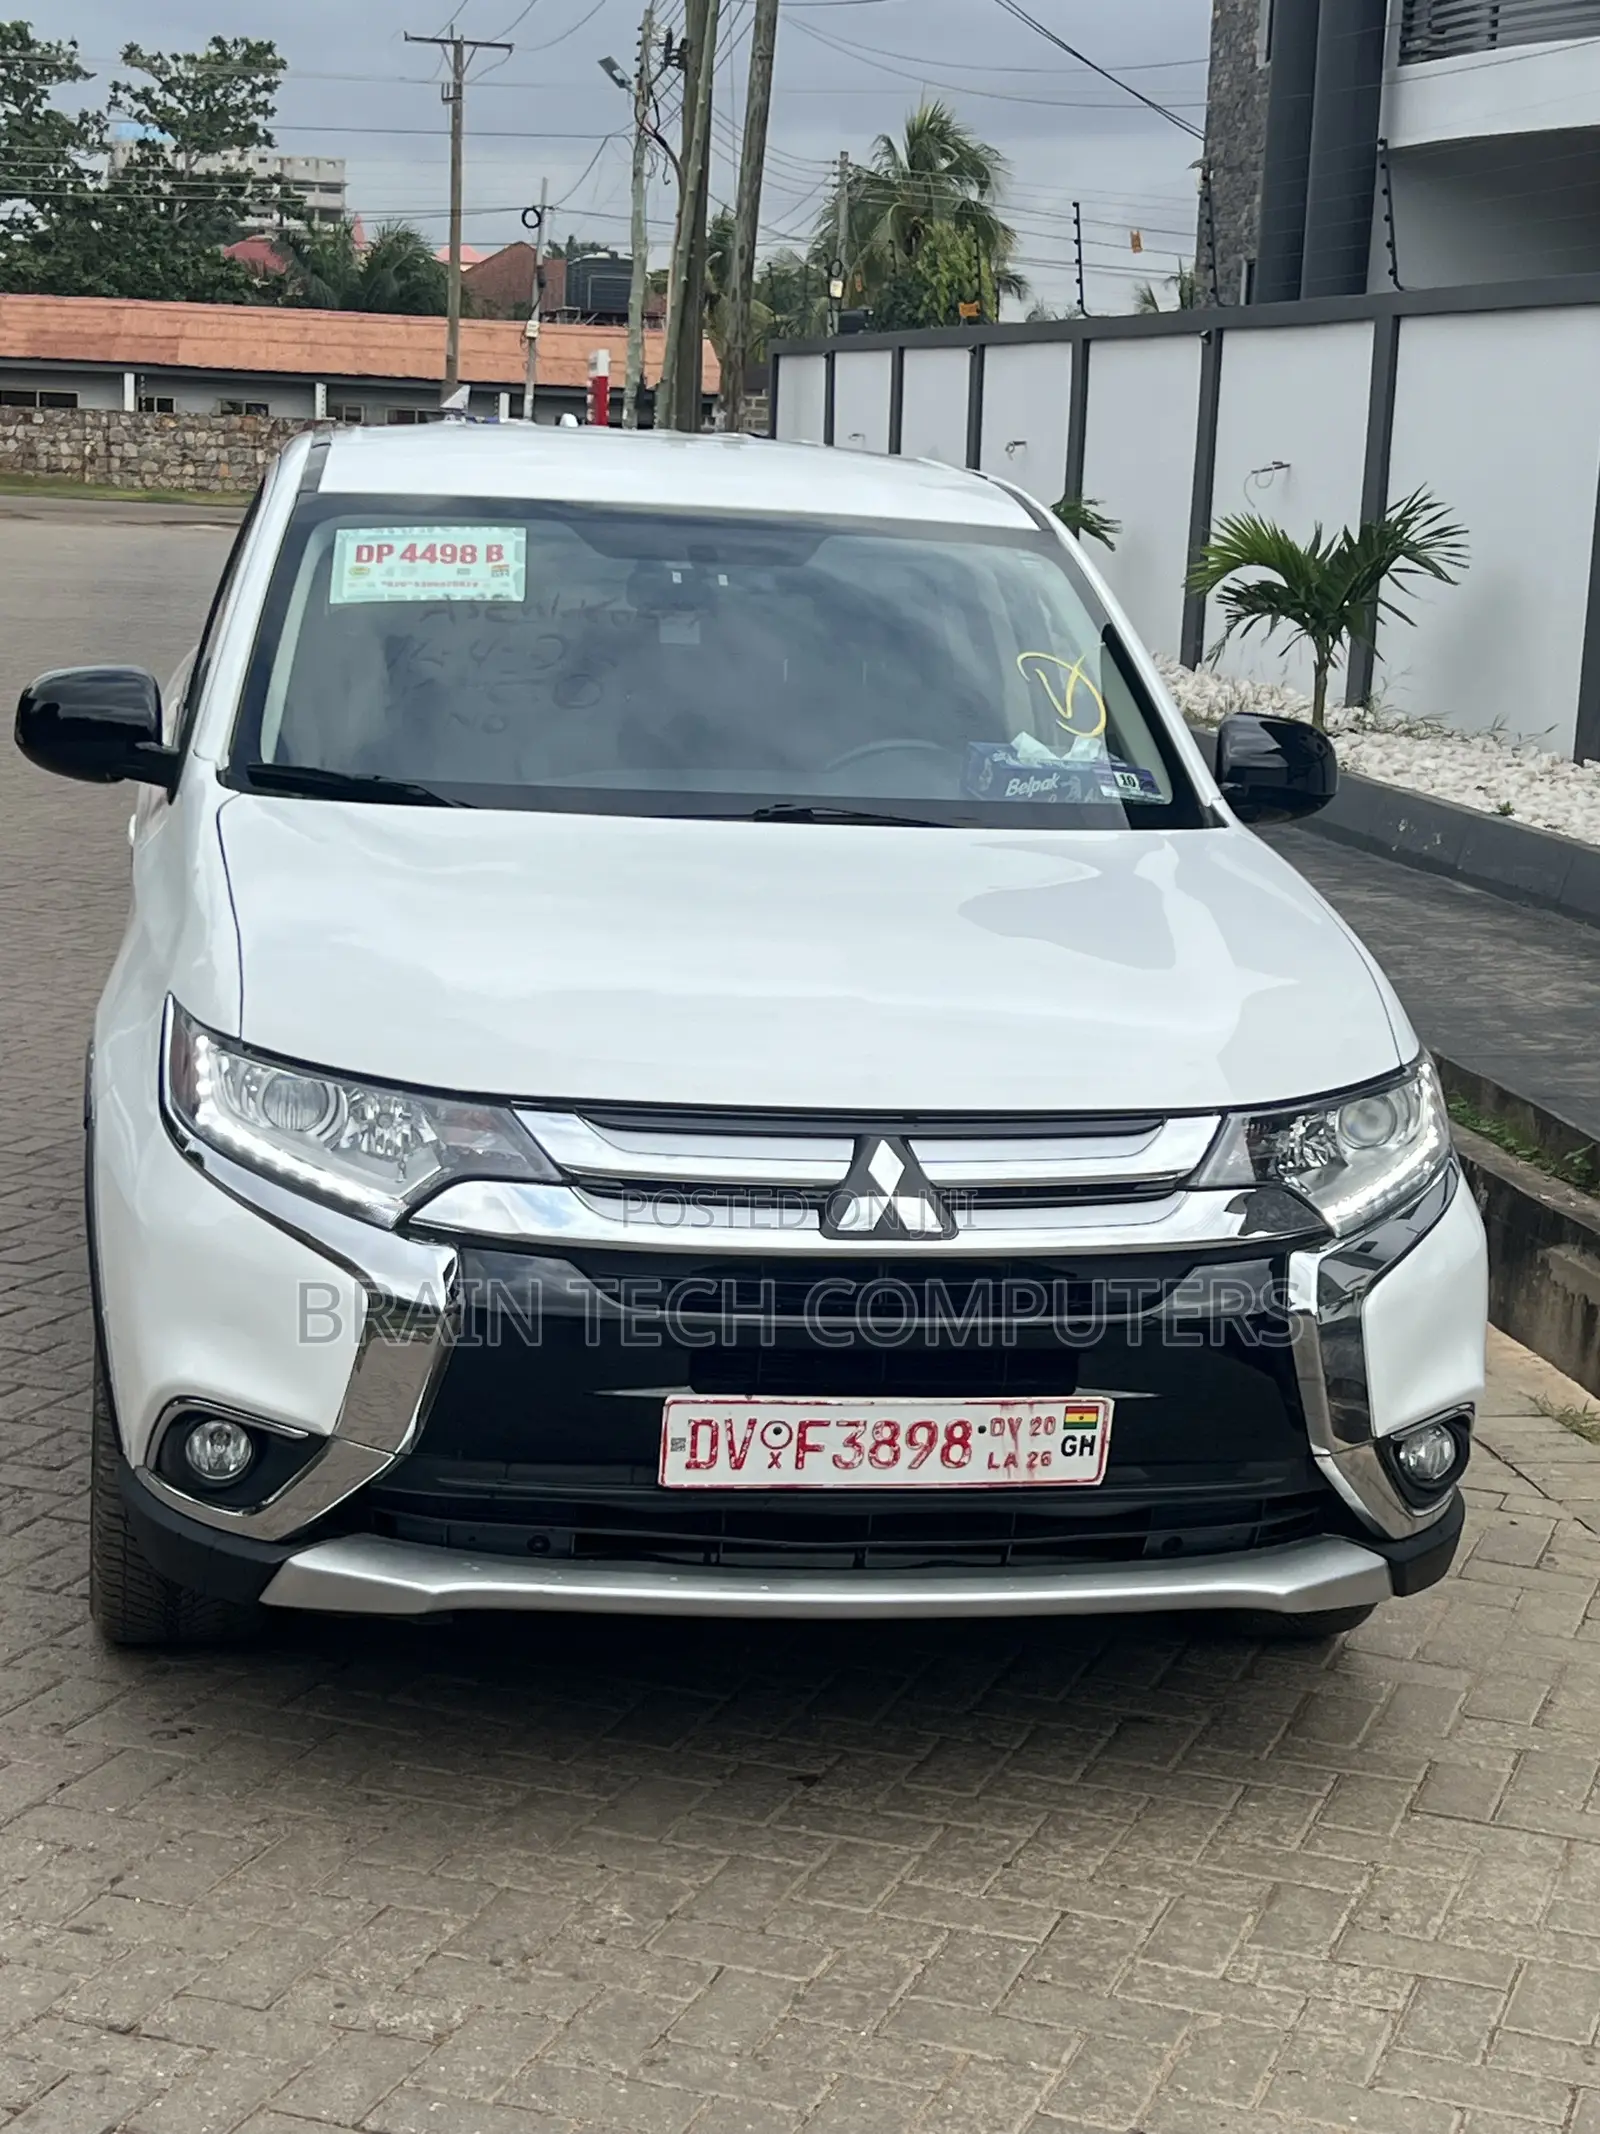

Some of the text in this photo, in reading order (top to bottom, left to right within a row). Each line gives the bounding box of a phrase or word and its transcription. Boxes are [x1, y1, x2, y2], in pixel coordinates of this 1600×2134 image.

[355, 542, 504, 565] DP 4498 B
[1061, 1434, 1097, 1457] GH
[987, 1451, 1019, 1470] LA
